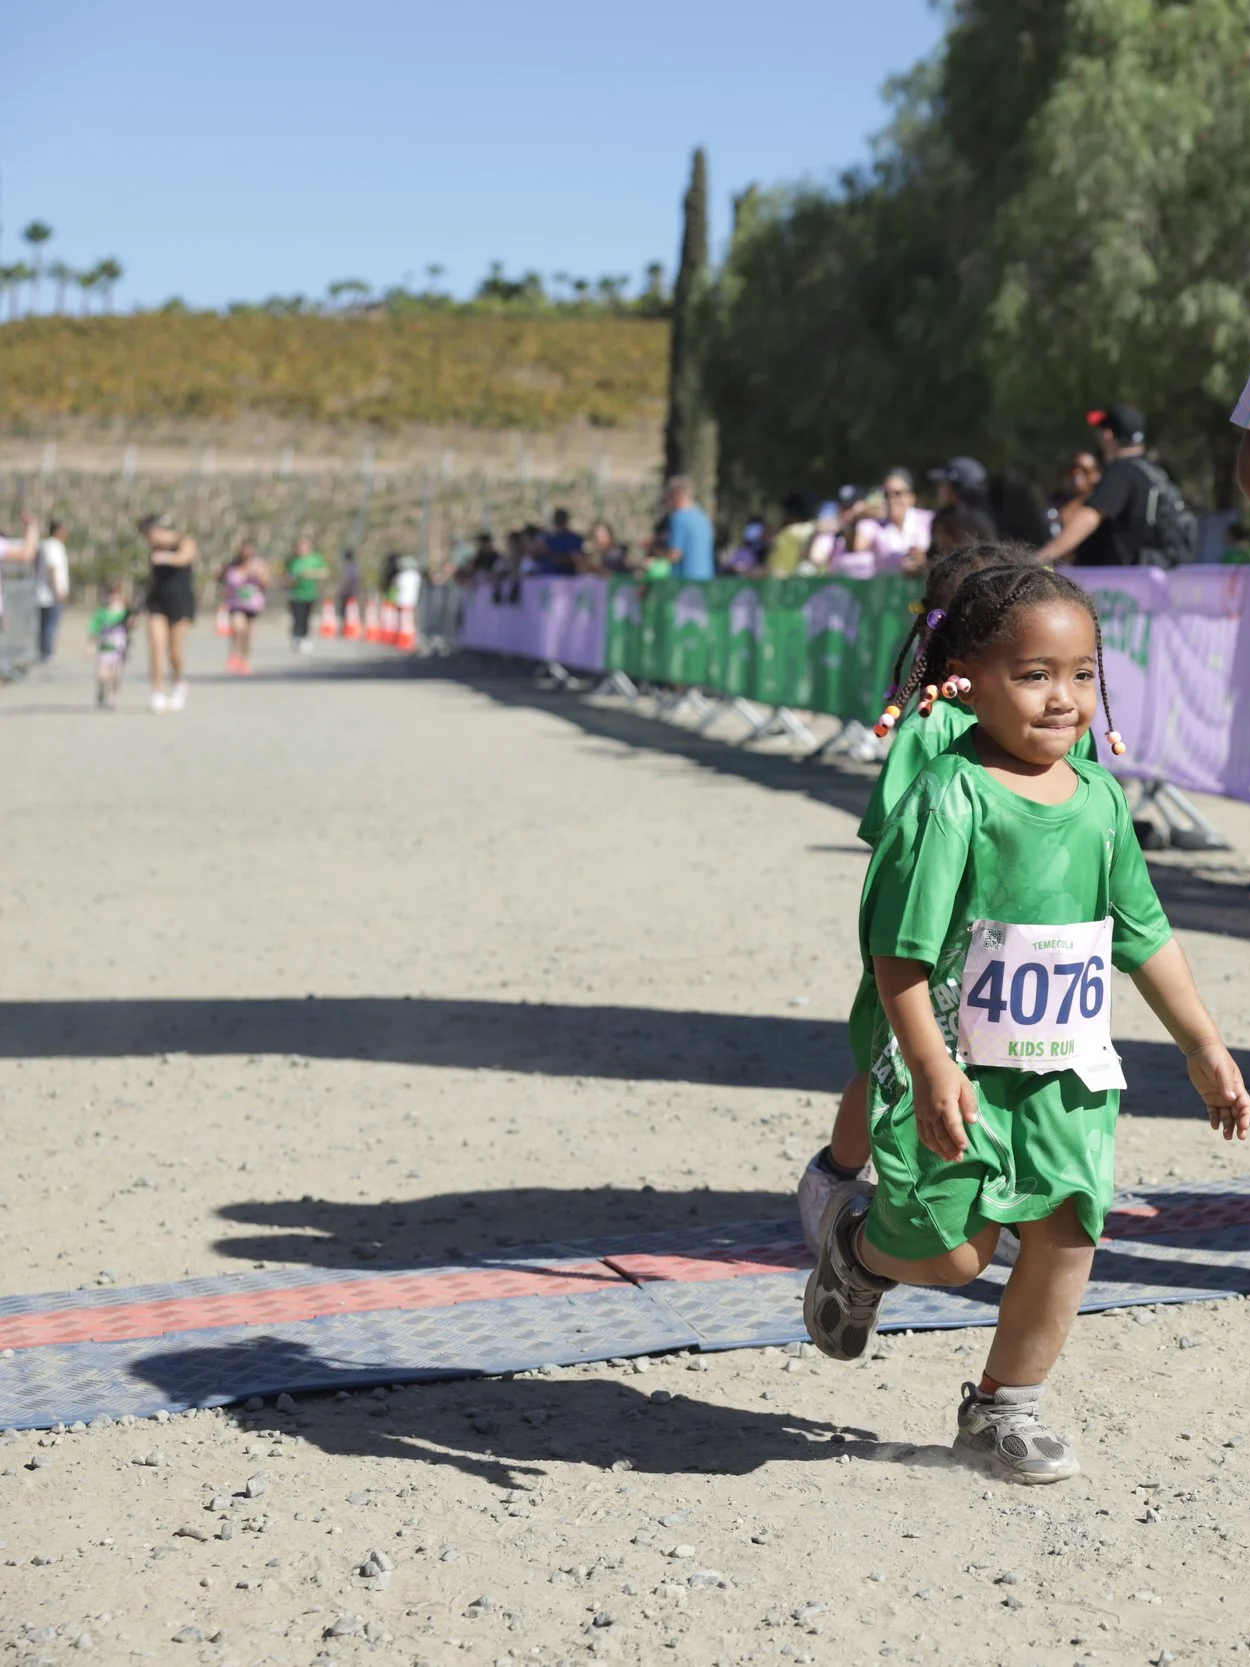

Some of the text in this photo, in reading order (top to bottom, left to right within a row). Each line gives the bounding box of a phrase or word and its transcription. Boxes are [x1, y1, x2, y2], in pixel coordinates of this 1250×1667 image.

[967, 955, 1105, 1026] 4076
[1008, 1039, 1075, 1057] KIDS RUN
